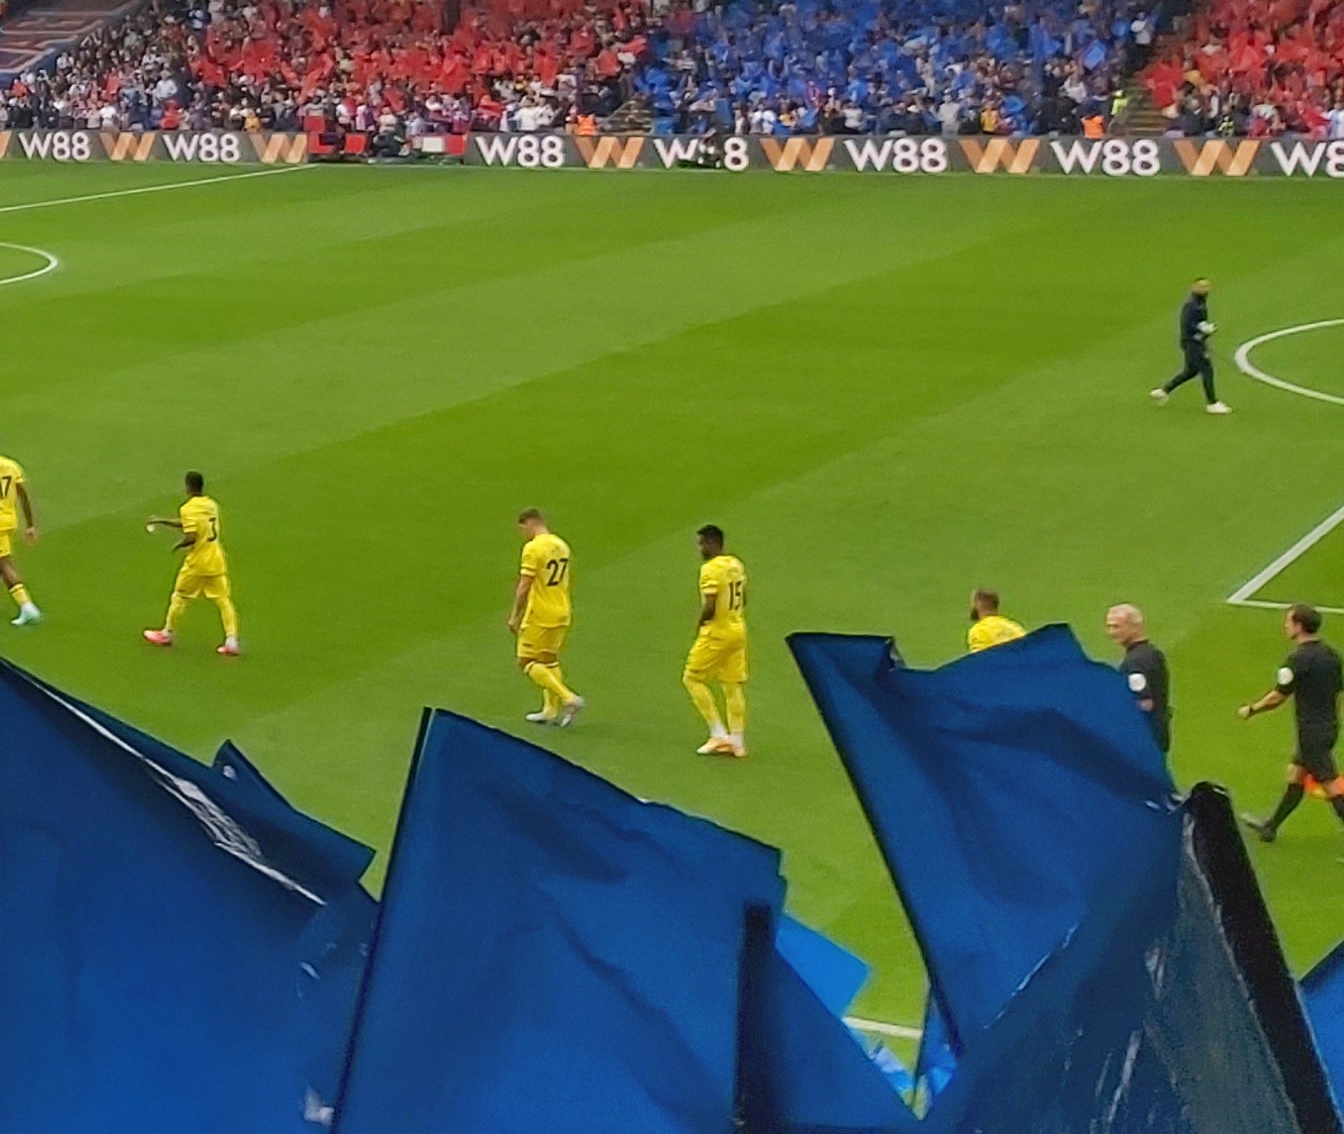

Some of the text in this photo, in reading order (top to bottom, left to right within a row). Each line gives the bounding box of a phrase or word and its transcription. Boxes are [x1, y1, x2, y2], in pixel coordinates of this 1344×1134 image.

[18, 131, 91, 161] W88
[163, 133, 241, 163] W88
[475, 134, 565, 168] W88
[653, 136, 750, 172] W8
[843, 137, 948, 173] W88
[1050, 138, 1161, 176] W88
[206, 516, 218, 542] 3
[546, 558, 569, 587] 27
